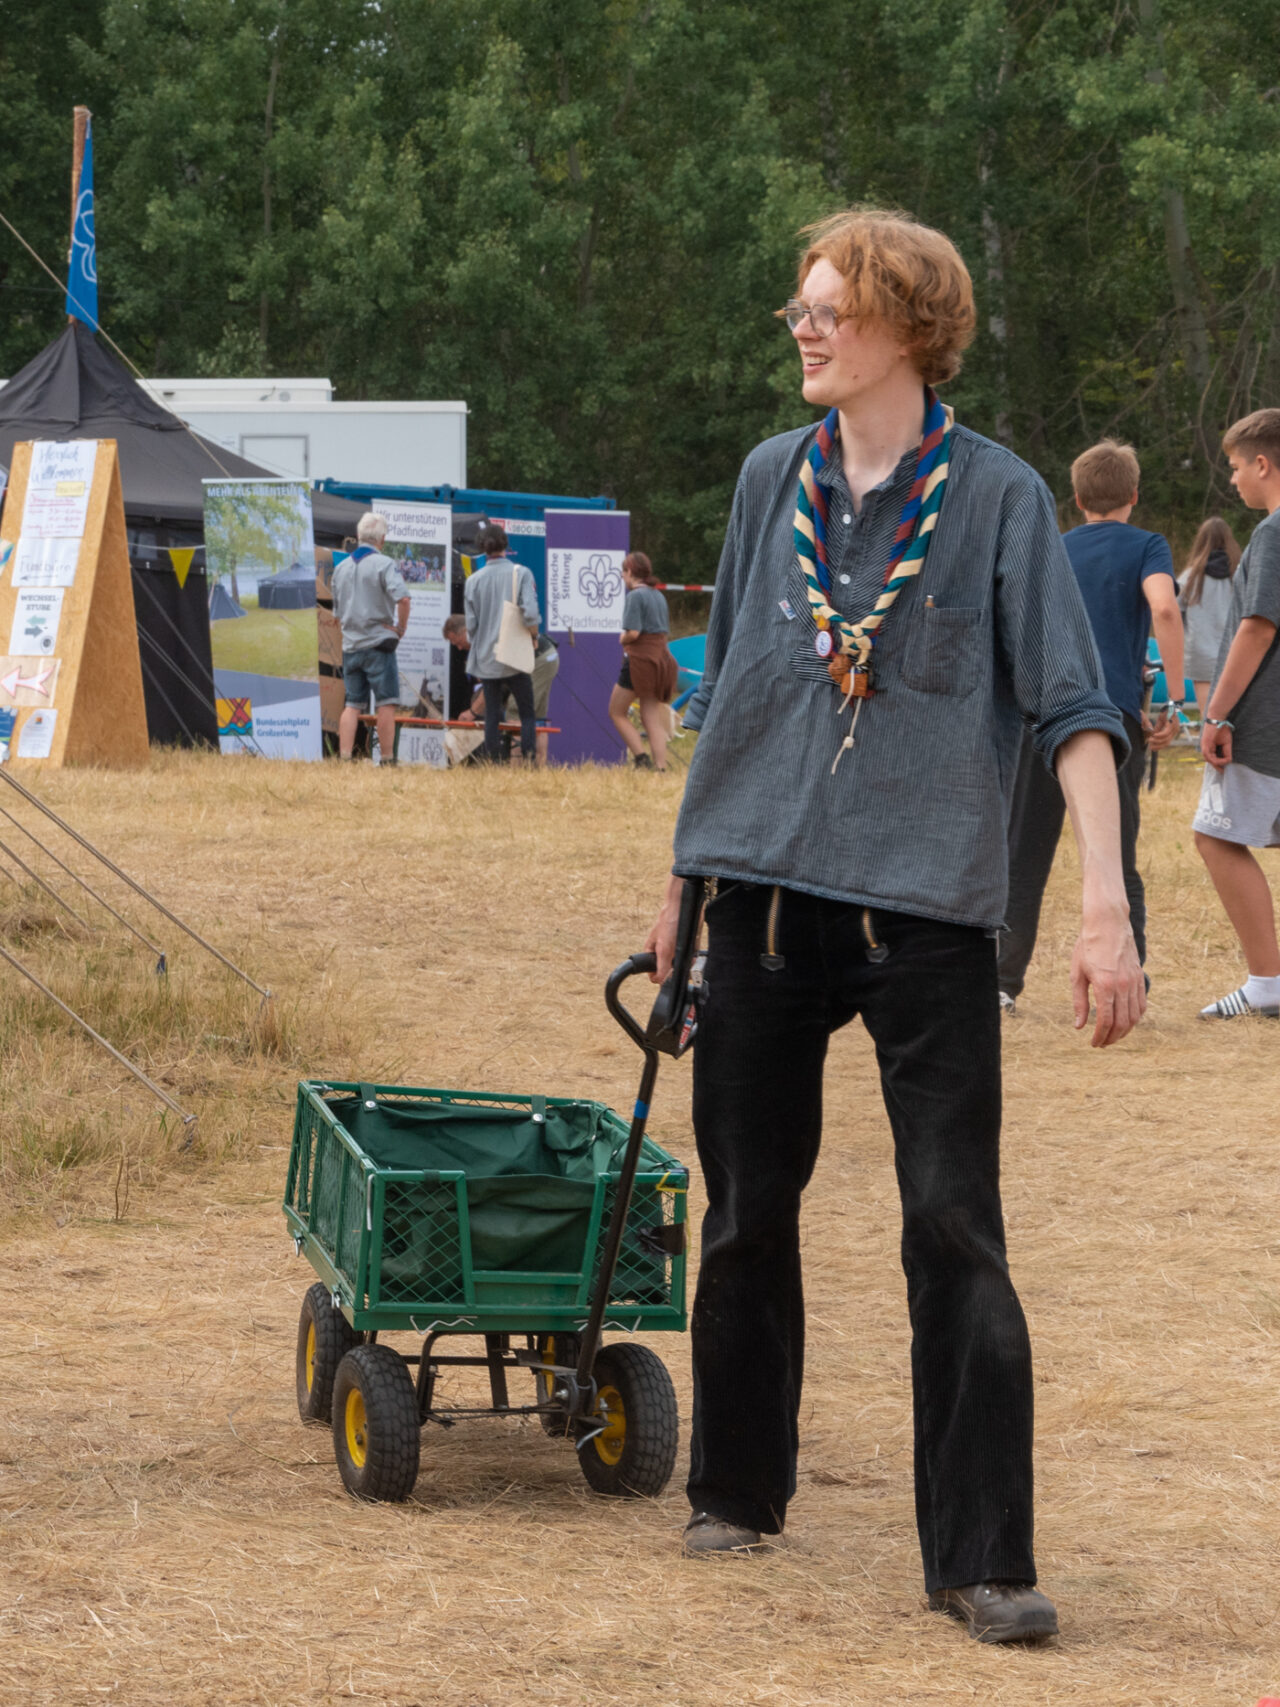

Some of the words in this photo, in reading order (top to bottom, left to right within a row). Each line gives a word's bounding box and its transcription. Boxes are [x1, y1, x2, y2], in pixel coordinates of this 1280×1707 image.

[393, 512, 447, 526] unterstützen
[387, 524, 437, 538] Pfadfinden!
[561, 552, 573, 600] Stiftung
[550, 552, 561, 627] Evangelische
[562, 614, 620, 628] Pfadfinden
[255, 717, 310, 728] Bundeszeltplatz
